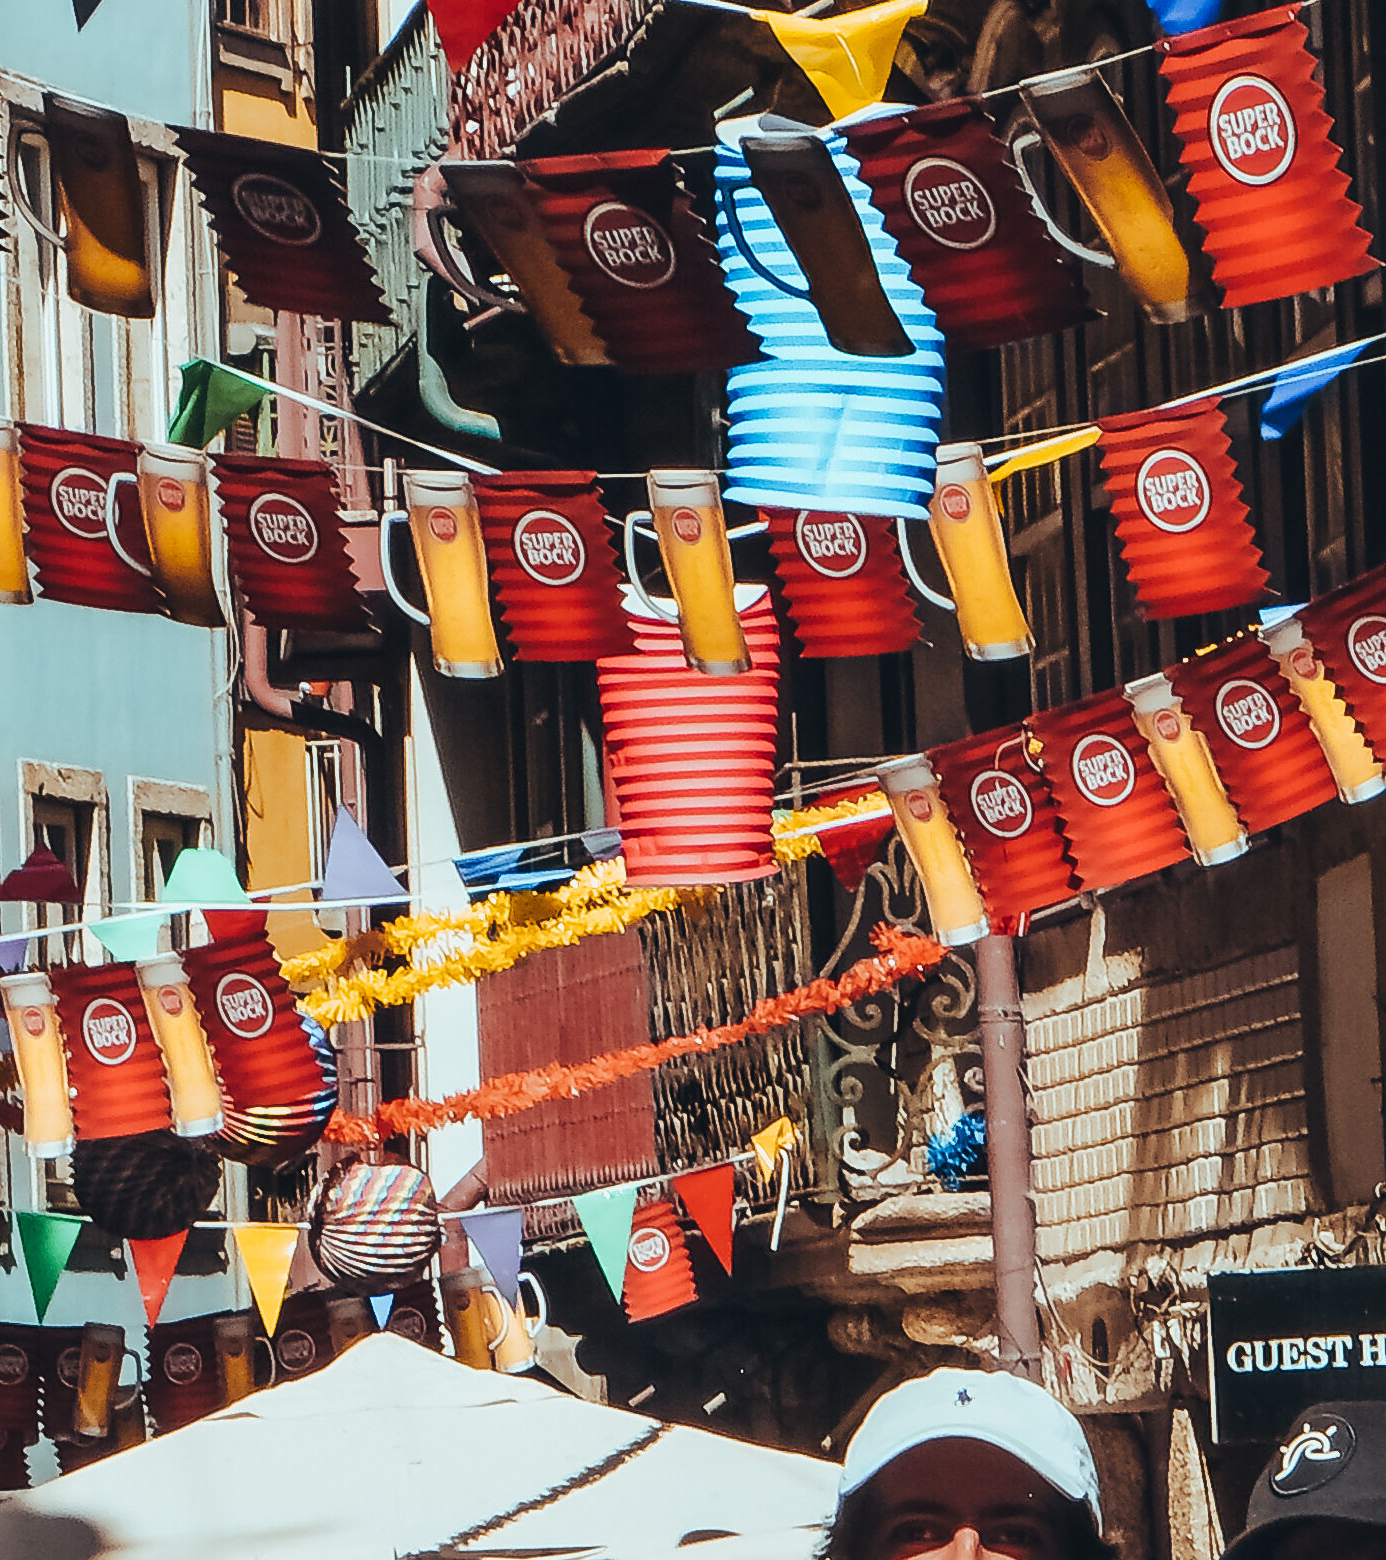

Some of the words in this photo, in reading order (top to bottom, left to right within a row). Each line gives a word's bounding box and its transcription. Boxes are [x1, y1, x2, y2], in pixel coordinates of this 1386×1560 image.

[1218, 102, 1281, 136] SUPER
[1223, 125, 1285, 161] BOCK
[913, 181, 978, 211] SUPER
[925, 200, 984, 229] BOCK
[592, 226, 655, 250] SUPER
[602, 242, 662, 267] BOCK
[1145, 469, 1198, 492] SUPER
[1149, 486, 1201, 514] BOCK
[256, 512, 308, 531] SUPER
[804, 521, 856, 541] SUPER
[260, 527, 310, 547] BOCK
[522, 532, 576, 552] SUPER
[526, 548, 577, 566] BOCK
[809, 538, 858, 559] BOCK
[1222, 692, 1265, 719] SUPER
[1229, 710, 1272, 736] BOCK
[1078, 749, 1121, 773] SUPER
[1084, 768, 1128, 790] BOCK
[982, 802, 1025, 824] BOCK
[221, 988, 262, 1010] SUPER
[88, 1014, 127, 1032] SUPER
[227, 1004, 266, 1023] BOCK
[90, 1030, 129, 1048] BOCK
[1226, 1335, 1353, 1373] GUEST
